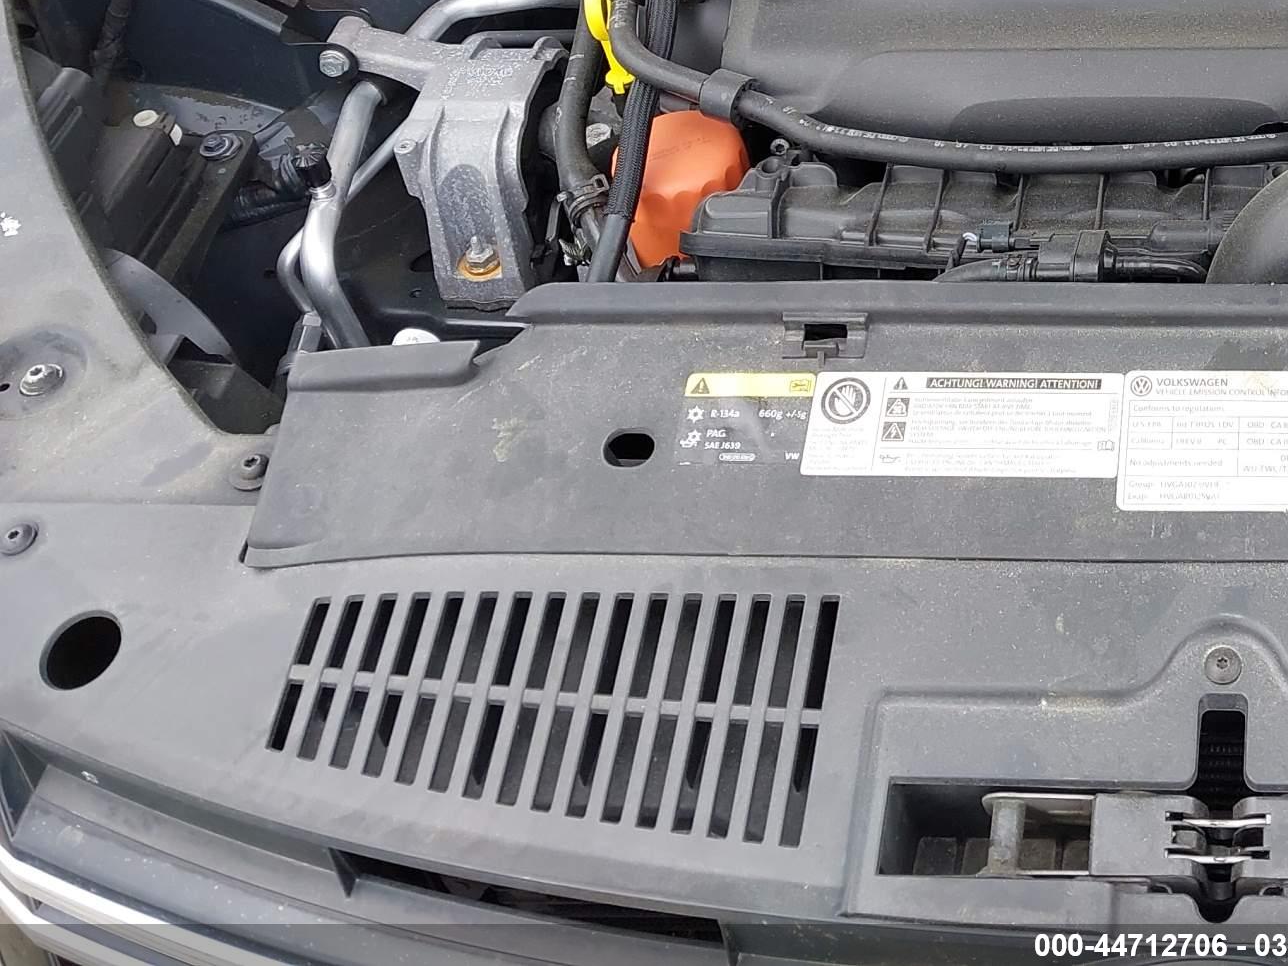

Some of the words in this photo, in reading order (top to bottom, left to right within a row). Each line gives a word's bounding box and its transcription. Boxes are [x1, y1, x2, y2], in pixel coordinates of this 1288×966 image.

[929, 378, 983, 388] ACHTUNG!
[986, 378, 1038, 388] WARNING!
[1040, 379, 1098, 389] ATTENTION!
[1156, 377, 1229, 387] VOLKSWAGEN
[1189, 388, 1227, 396] EMISSION
[1228, 388, 1265, 396] CONTROL
[710, 409, 740, 419] R-134a
[758, 409, 784, 420] 660g
[706, 429, 727, 438] PAG
[703, 441, 720, 450] SAE
[720, 441, 742, 450] J639
[784, 452, 801, 461] VW
